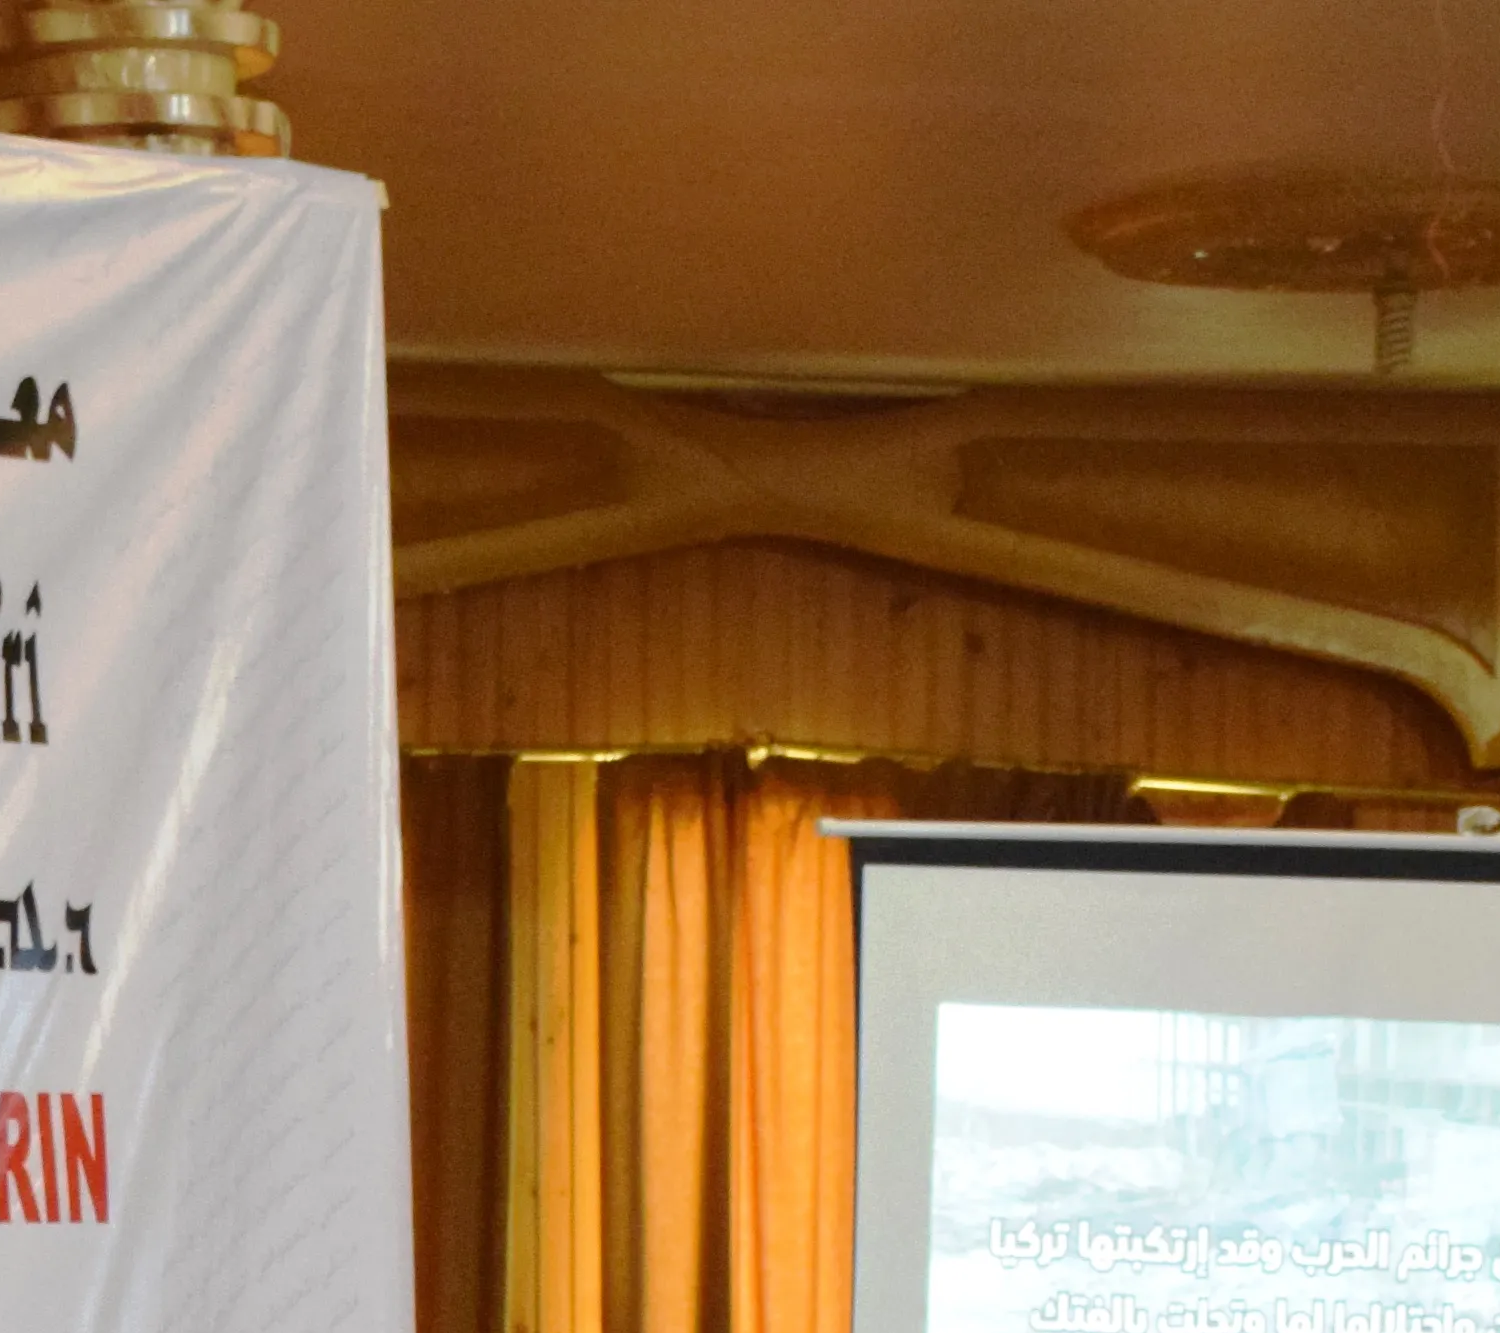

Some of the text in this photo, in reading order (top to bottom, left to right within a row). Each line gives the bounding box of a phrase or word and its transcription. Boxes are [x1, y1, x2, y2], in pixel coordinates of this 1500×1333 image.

[989, 1218, 1068, 1268] تركيا
[1217, 1231, 1283, 1272] وقد
[1291, 1229, 1390, 1276] الحرب
[1397, 1228, 1482, 1283] جرائم
